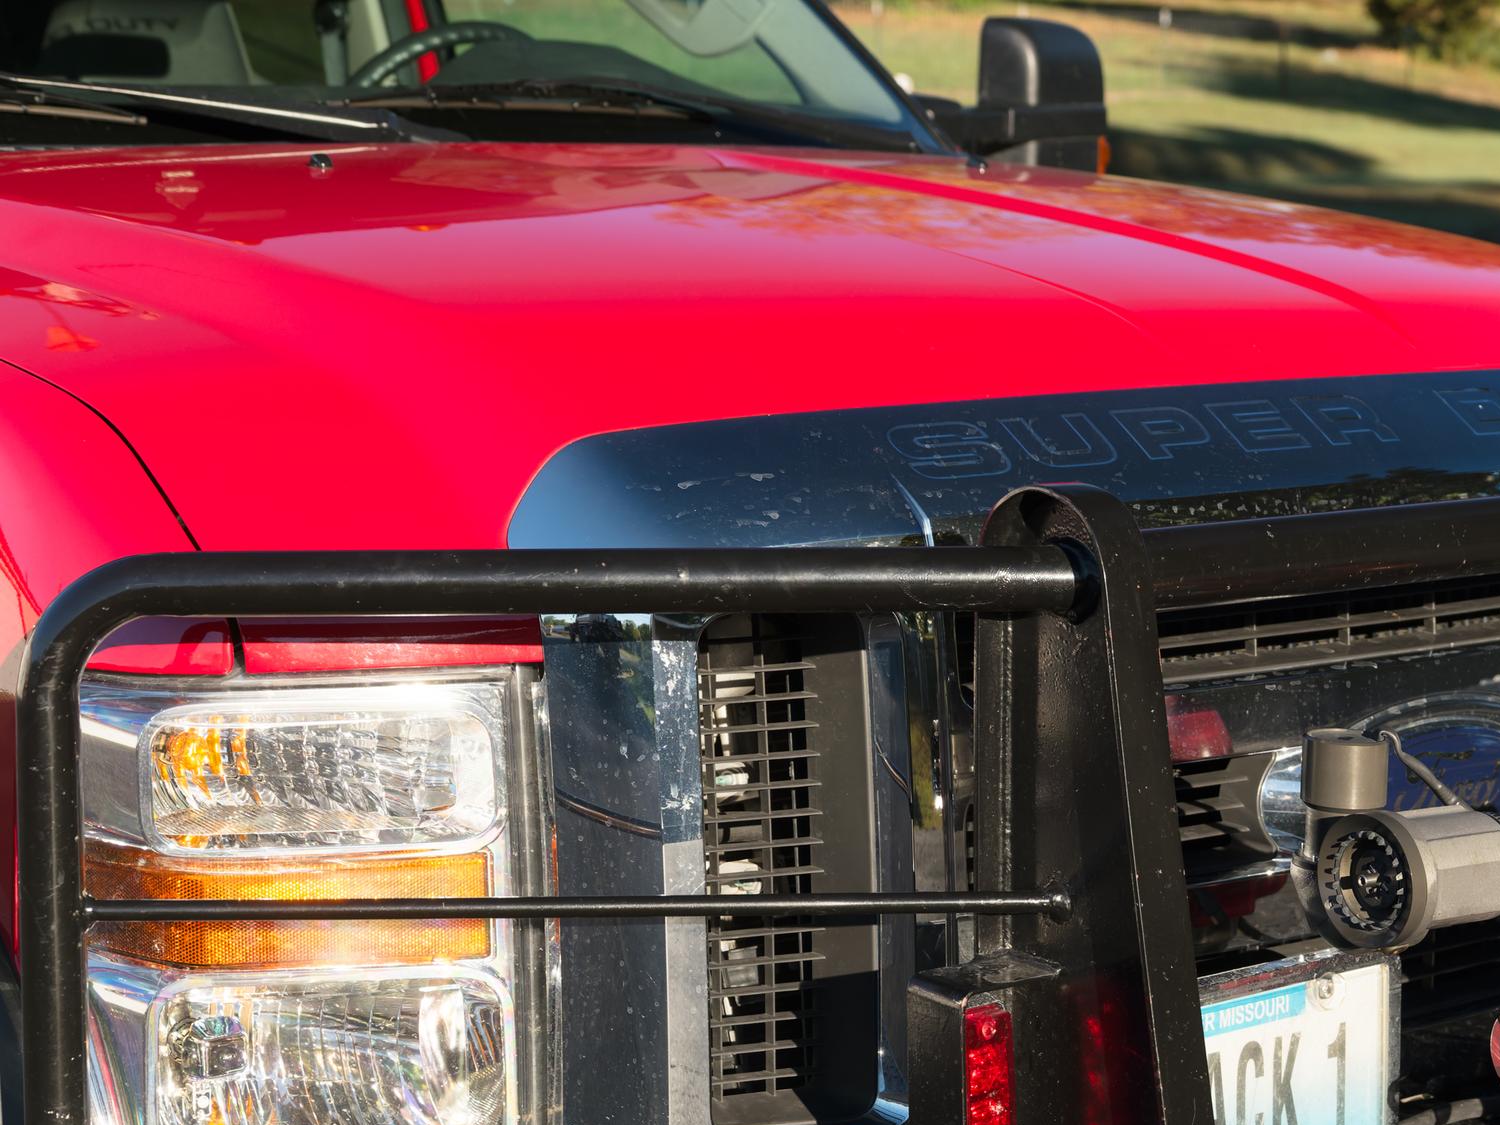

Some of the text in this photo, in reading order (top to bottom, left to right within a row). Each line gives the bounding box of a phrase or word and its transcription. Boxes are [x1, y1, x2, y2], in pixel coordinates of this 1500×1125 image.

[887, 394, 1400, 479] SUPER
[1202, 994, 1290, 1032] R MISSOURI
